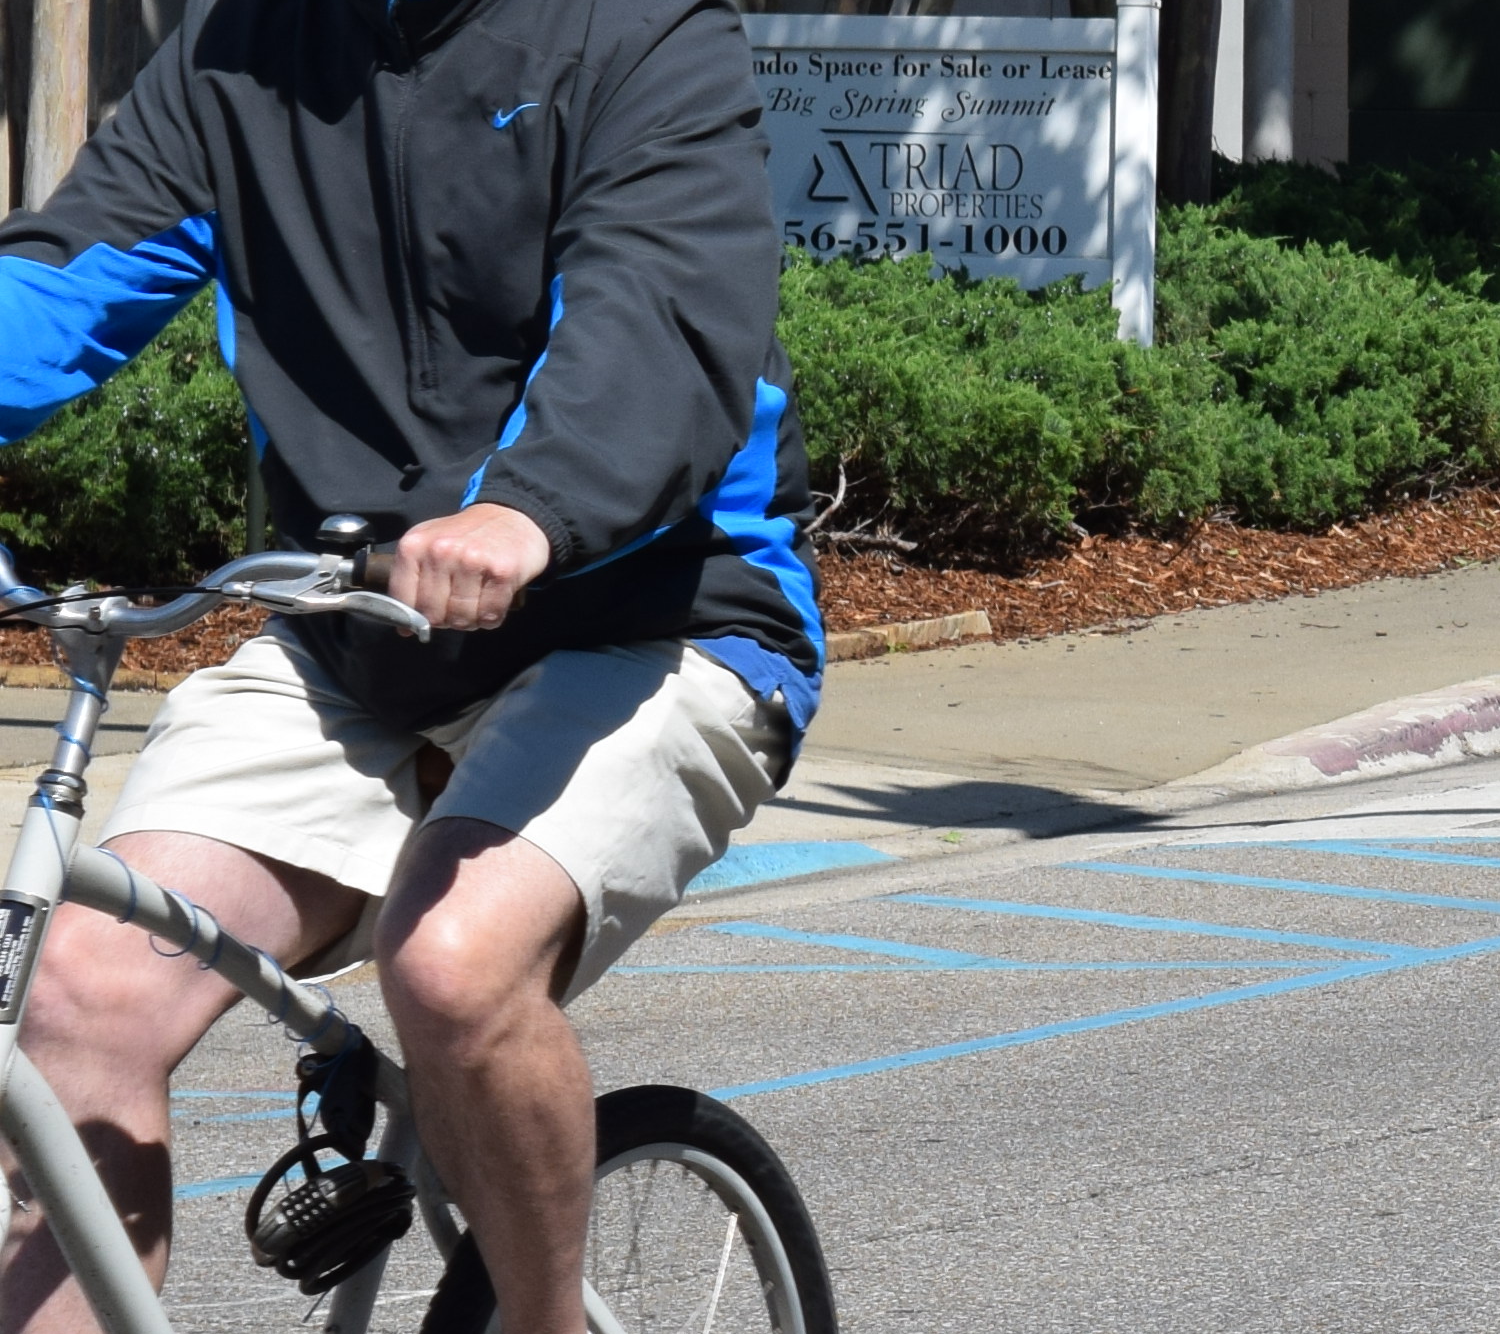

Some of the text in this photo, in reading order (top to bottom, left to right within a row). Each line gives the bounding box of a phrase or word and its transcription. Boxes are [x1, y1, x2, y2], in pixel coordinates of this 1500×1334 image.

[752, 52, 1112, 83] ndo Space for Sale or Lease
[767, 87, 1056, 123] Big Spring Summit
[869, 142, 1024, 191] TRIAD
[889, 192, 1044, 219] PROPERTIES
[784, 220, 1067, 256] 56-551-1000
